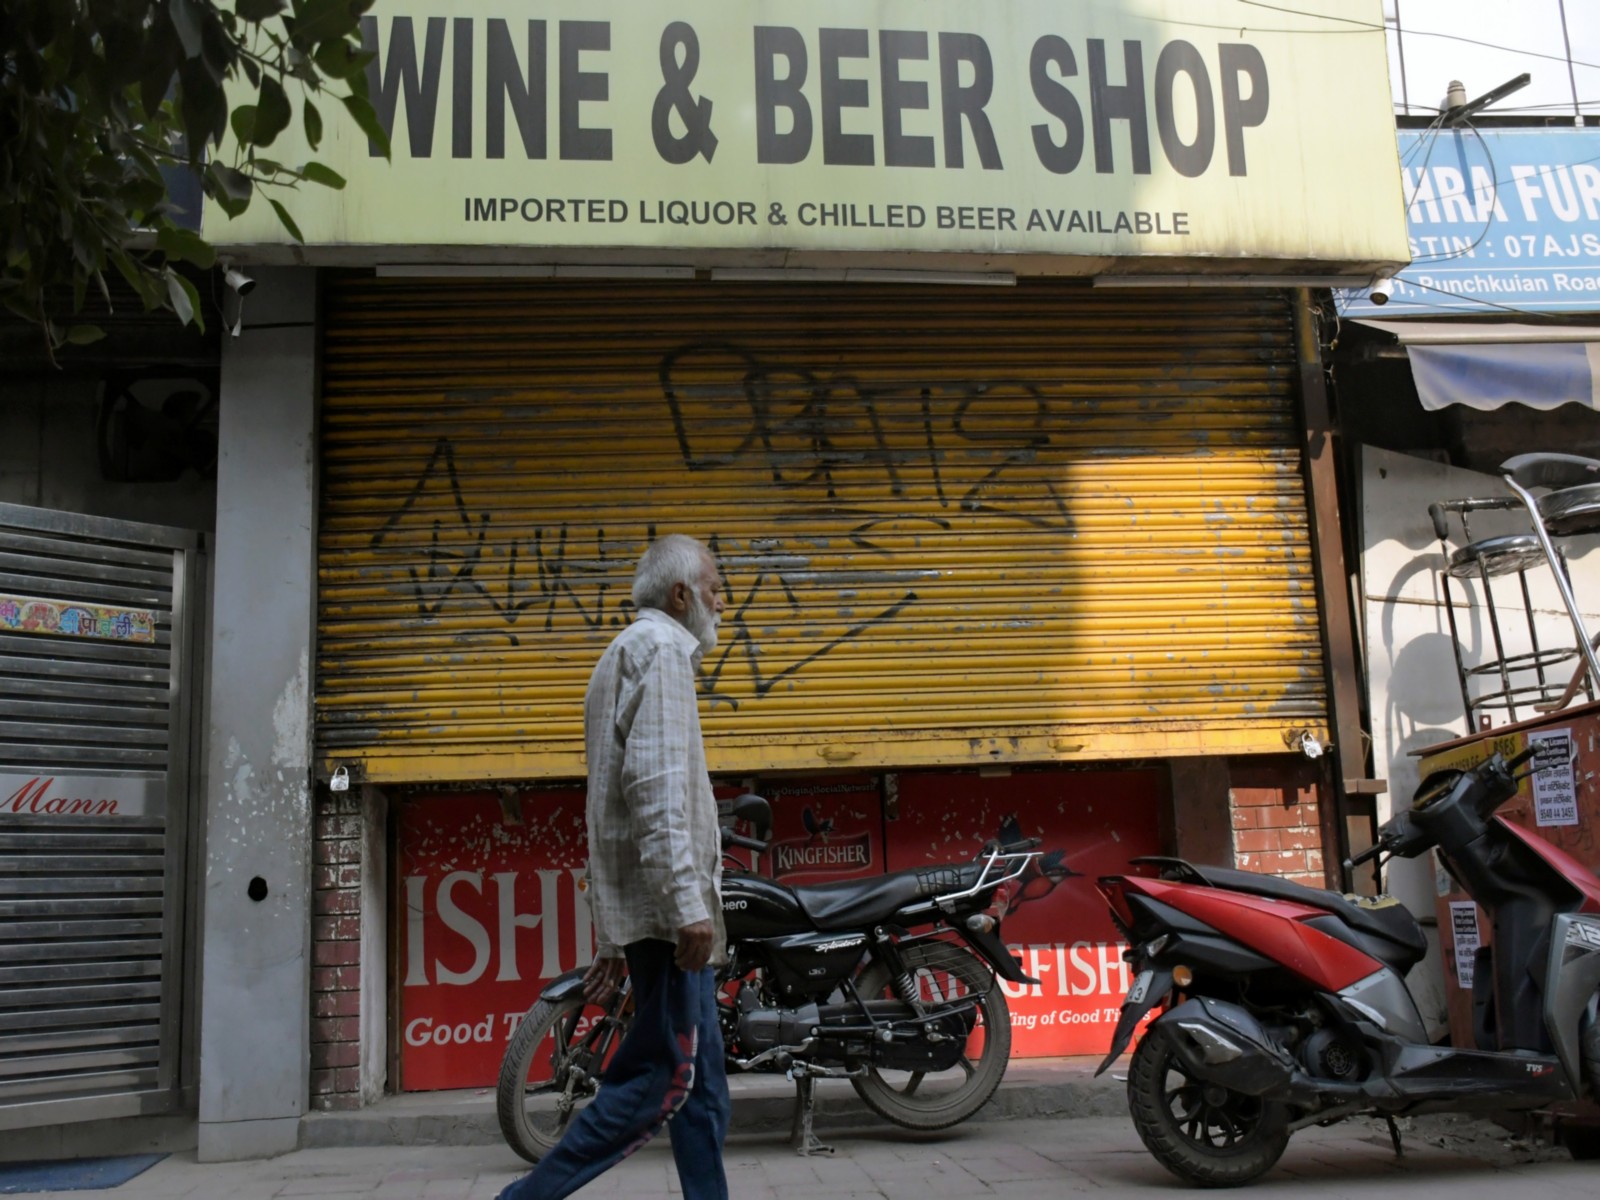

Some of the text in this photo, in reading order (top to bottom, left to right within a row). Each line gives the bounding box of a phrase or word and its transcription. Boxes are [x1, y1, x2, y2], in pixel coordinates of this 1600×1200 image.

[360, 16, 1270, 178] WINE & BEER SHOP
[464, 198, 1191, 235] IMPORTED LIQUOR & CHILLED BEER AVAILABLE
[1419, 273, 1549, 294] Punchkuian
[1553, 272, 1600, 292] Roa
[0, 777, 120, 816] Mann
[777, 844, 868, 870] KINGFISHER
[405, 1013, 494, 1047] Good
[1009, 1012, 1037, 1030] ing
[1040, 1010, 1057, 1025] of
[1058, 1008, 1101, 1025] Good
[1526, 1063, 1543, 1073] TVS
